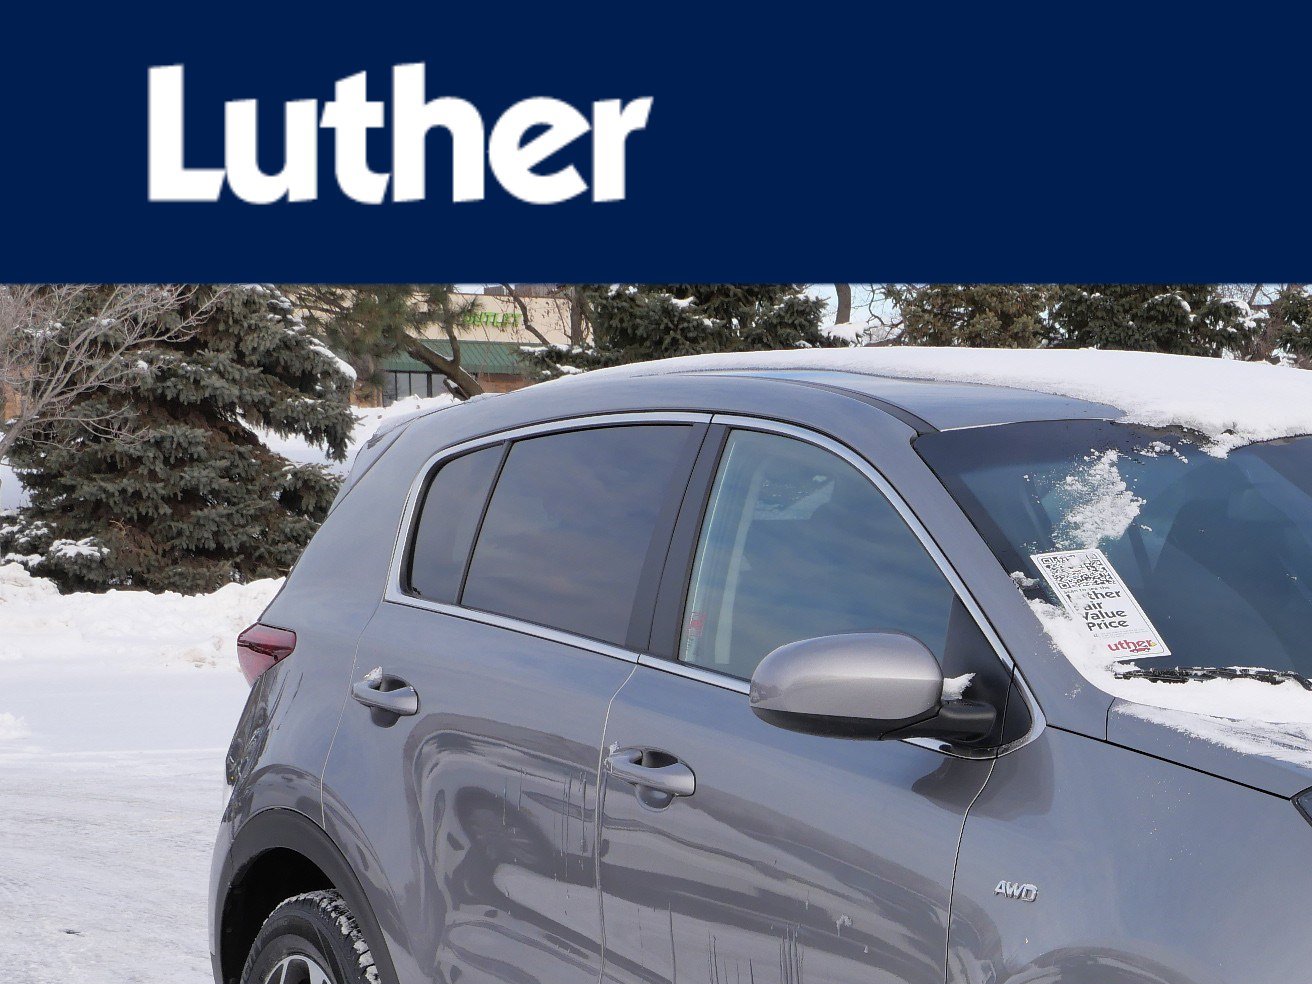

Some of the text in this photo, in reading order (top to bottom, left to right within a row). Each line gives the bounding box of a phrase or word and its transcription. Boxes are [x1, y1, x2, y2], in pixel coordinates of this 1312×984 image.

[1086, 619, 1129, 632] Price
[1107, 639, 1151, 653] uther
[993, 879, 1039, 903] AWD
